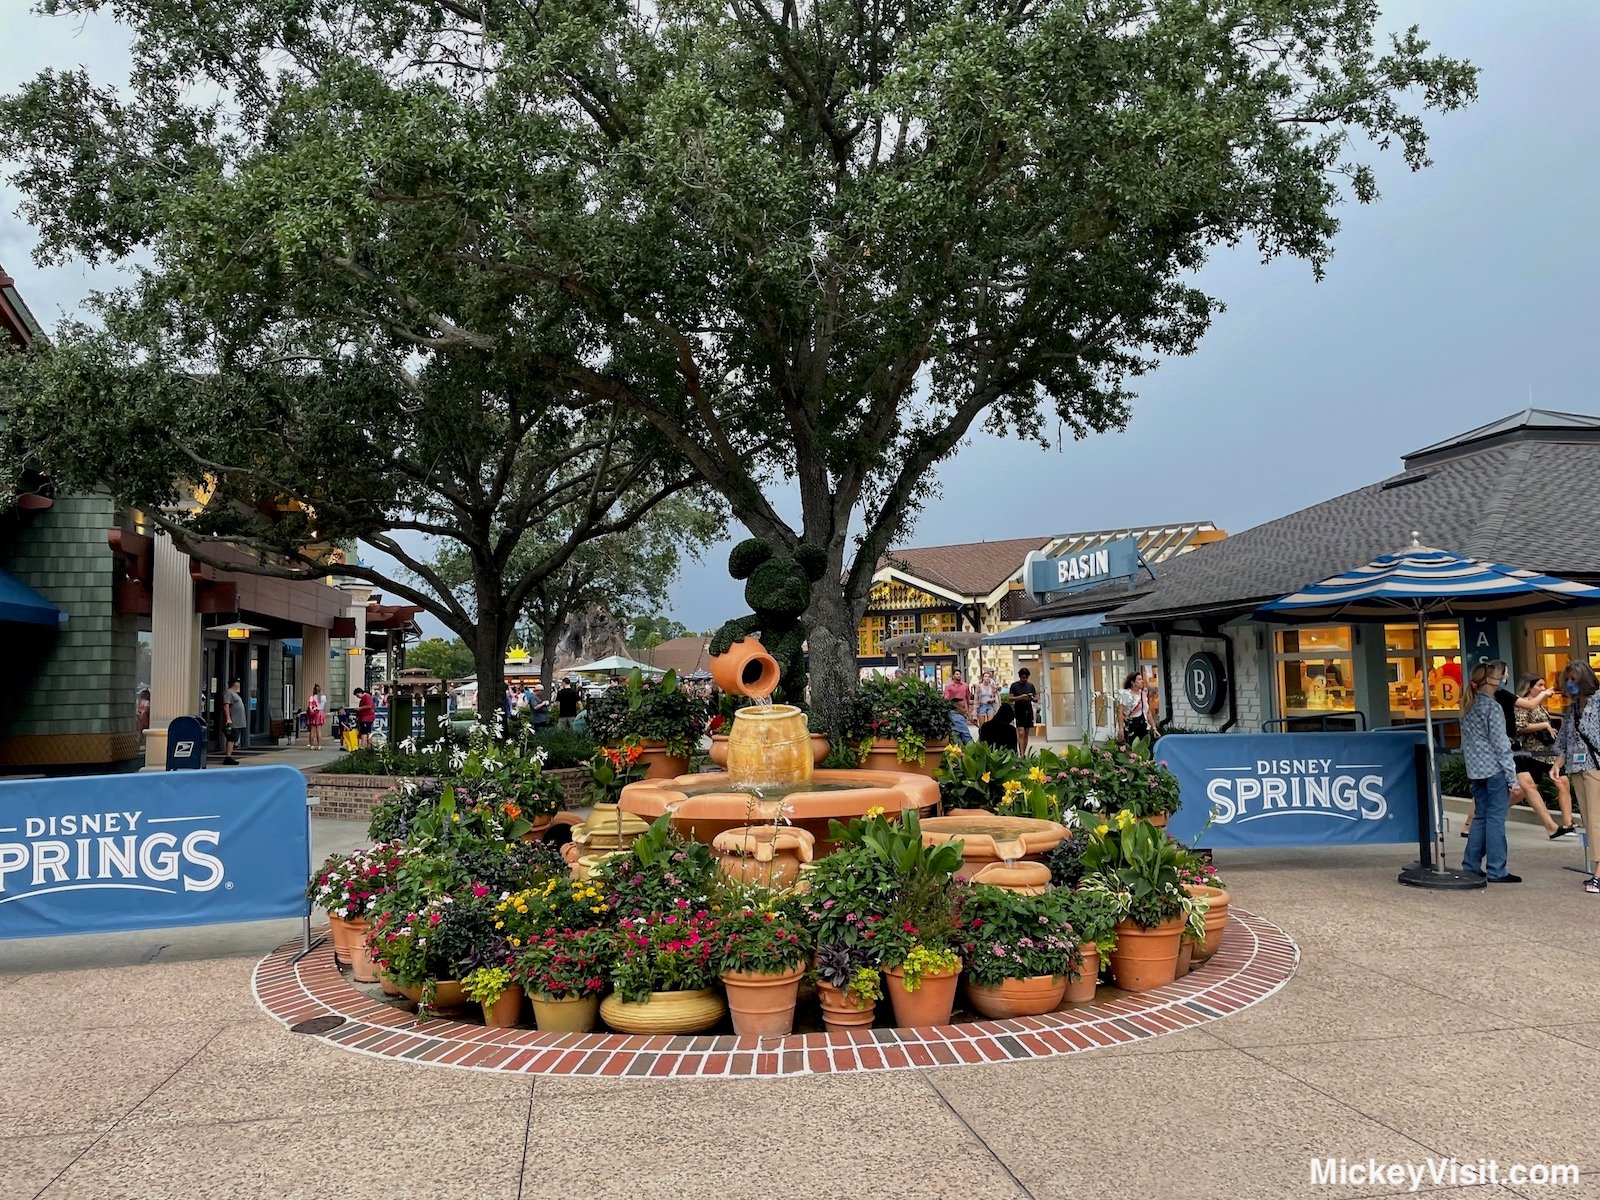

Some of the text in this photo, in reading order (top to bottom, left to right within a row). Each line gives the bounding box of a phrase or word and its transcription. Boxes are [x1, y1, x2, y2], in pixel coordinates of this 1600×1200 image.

[1058, 549, 1109, 583] BASIN
[1193, 669, 1206, 699] B
[1256, 759, 1333, 776] DISNEY
[1206, 775, 1388, 824] SPRINGS
[25, 811, 143, 837] DISNEY
[0, 829, 225, 892] PRINGS
